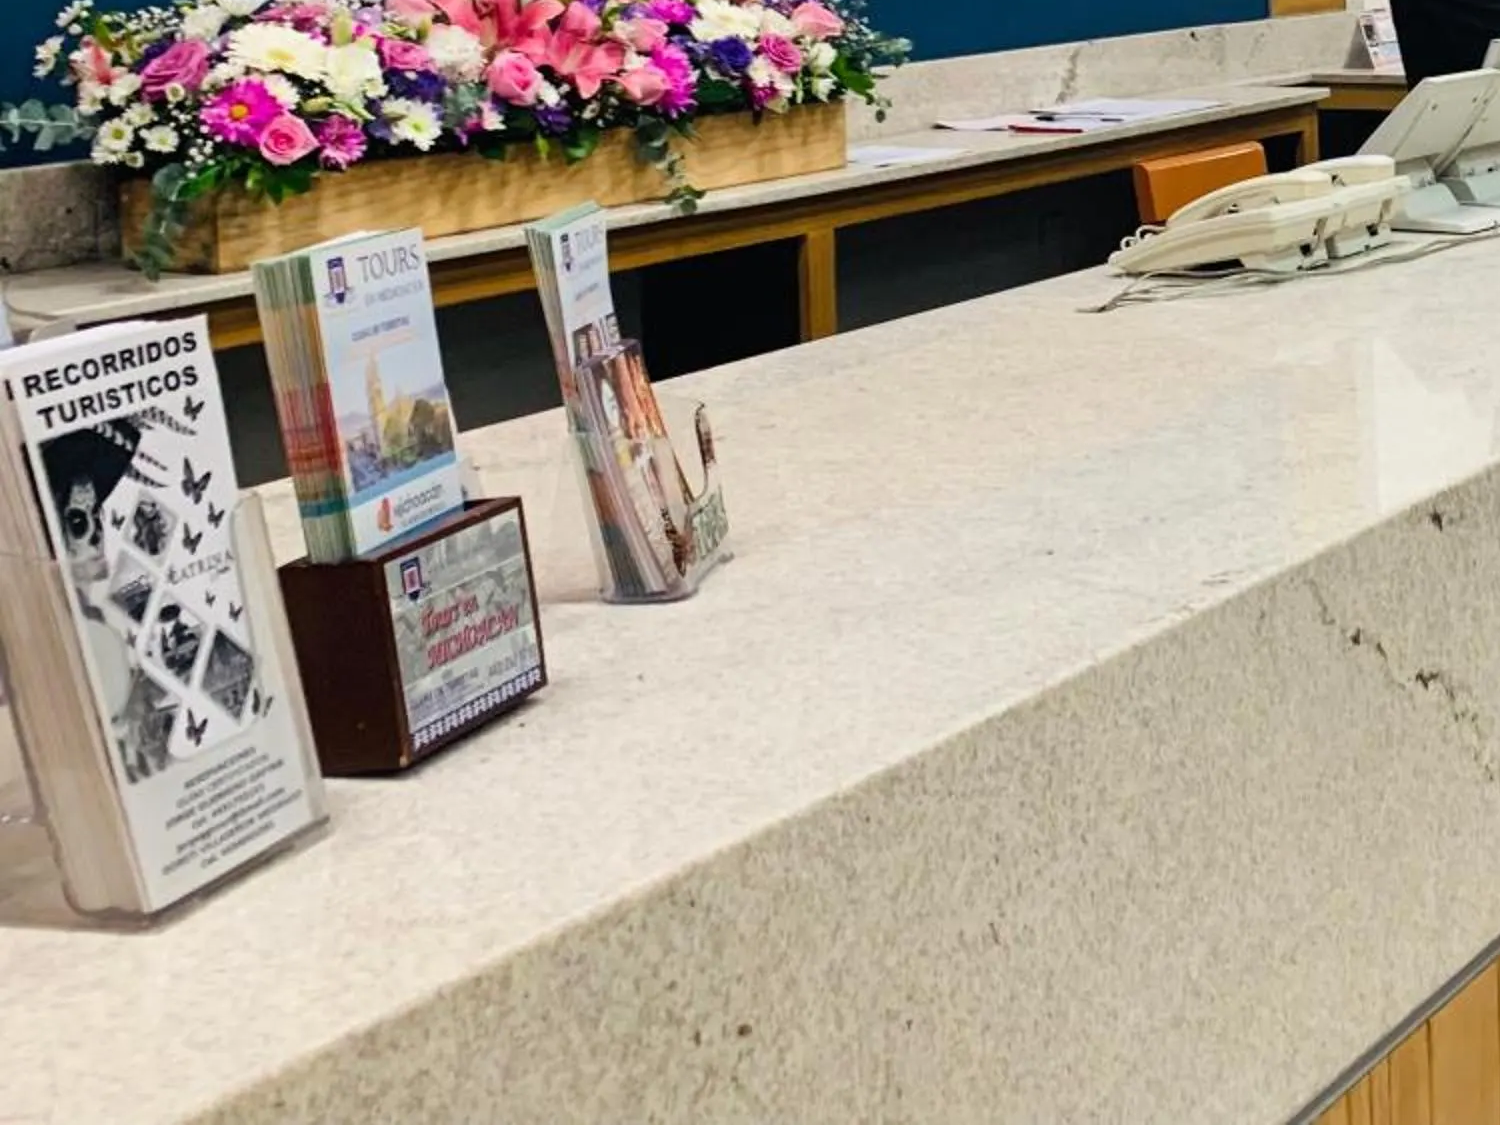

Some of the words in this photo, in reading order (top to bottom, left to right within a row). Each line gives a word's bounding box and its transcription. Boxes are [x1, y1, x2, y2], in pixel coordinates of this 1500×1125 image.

[356, 243, 420, 283] TOURS
[22, 331, 197, 398] RECORRIDOS
[37, 365, 199, 429] TURISTICOS
